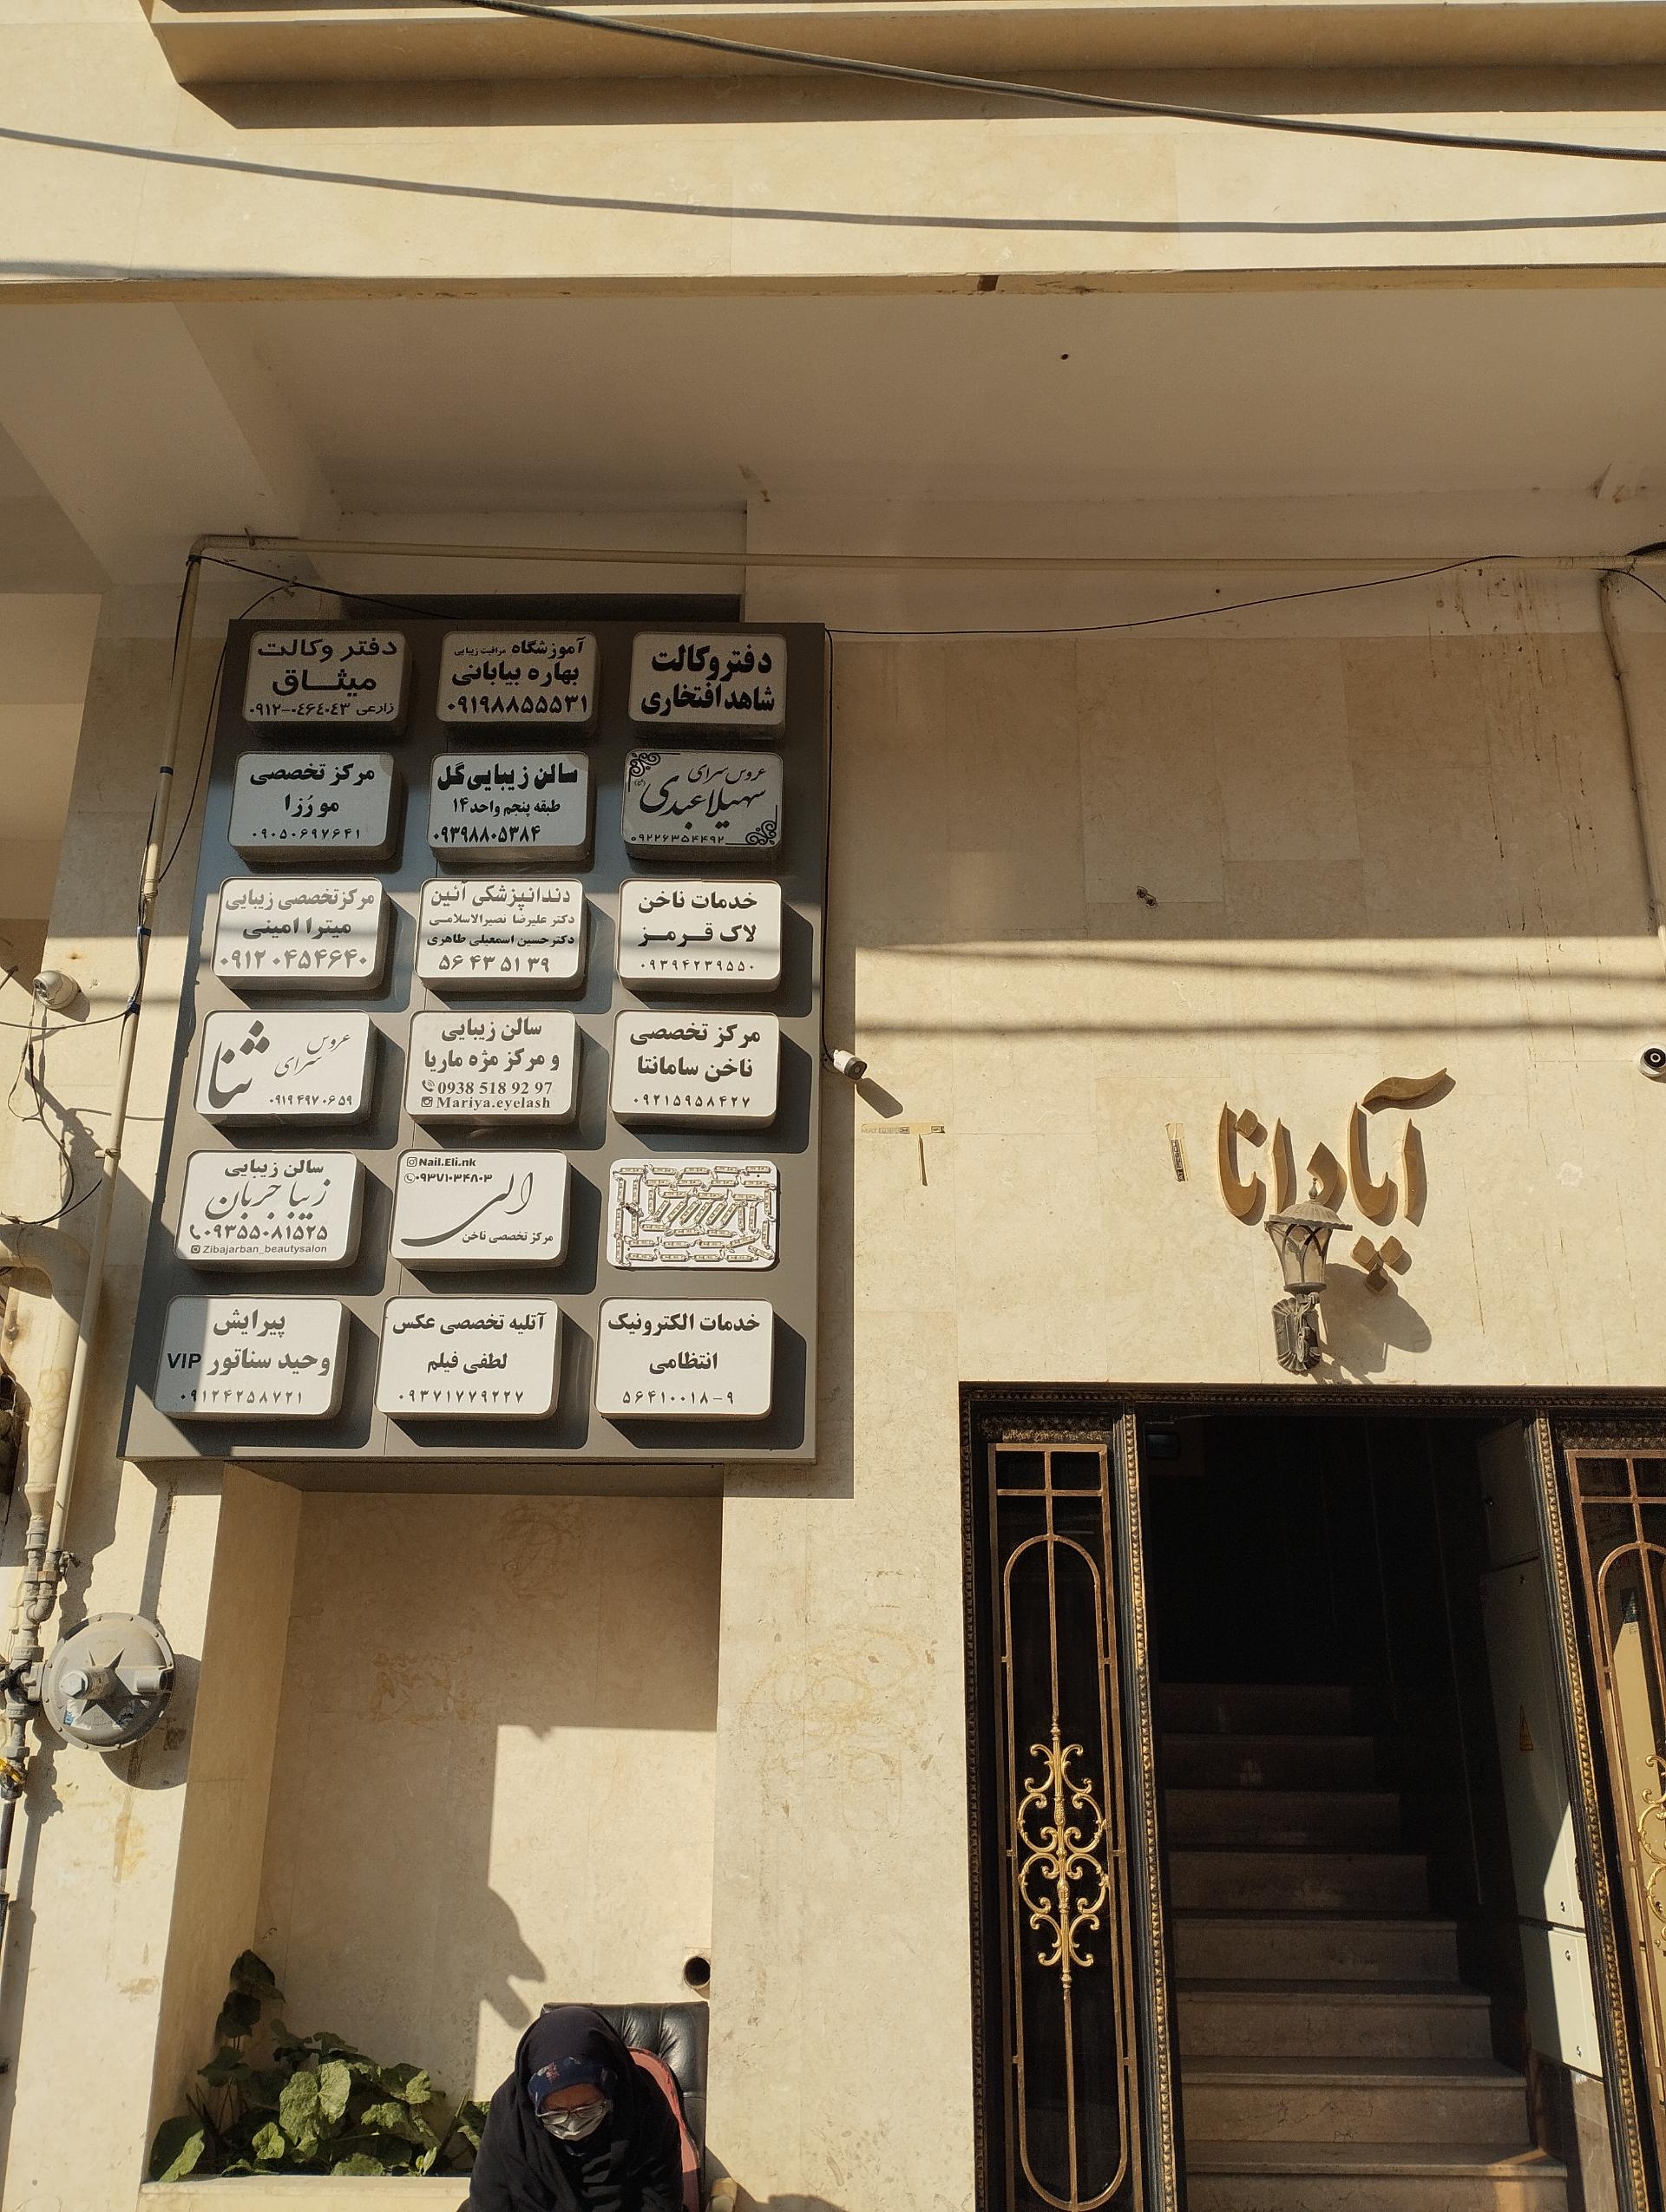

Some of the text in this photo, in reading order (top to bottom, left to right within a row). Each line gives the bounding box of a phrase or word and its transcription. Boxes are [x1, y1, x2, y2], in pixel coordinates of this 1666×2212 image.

[258, 637, 397, 663] دفتر وکالت
[511, 637, 587, 659] آموزشگاه
[451, 660, 579, 687] بهاره بیابانی
[652, 644, 772, 682] دفتر وکالت
[356, 703, 395, 716] زارعی
[447, 694, 587, 714] ۰۹۱۹۸۸۵۵۵۳۱
[641, 682, 775, 717] شاهد افتخاری
[249, 762, 375, 786] مرکز تخصصی
[437, 761, 578, 791] سالن زیبایی گل
[688, 763, 766, 785] عروس سرای
[453, 796, 561, 817] طبقه پنجم واحد ۱۴
[639, 775, 766, 830] سهیلا عبدی
[252, 828, 361, 840] ۰۹۰۵۰۶۹۷۶۴۱
[433, 825, 541, 843] ۰۹۳۹۸۸۰۵۳۸۴
[226, 887, 375, 910] مرکز تخصصی زیبایی
[430, 880, 571, 911] دندانپزشکی آئین
[638, 891, 758, 913] خدمات ناخن
[242, 916, 351, 939] میترا امینی
[512, 913, 548, 927] علیرضا
[549, 913, 575, 927] دکتر
[426, 933, 574, 948] دکتر حسین اسمعیلی طاهری
[719, 924, 757, 943] لاک
[640, 959, 755, 972] ۰۹۳۹۴۲۳۹۵۵۰
[442, 1017, 542, 1042] سالن زیبایی
[630, 1022, 760, 1048] مرکز تخصصی
[306, 1034, 351, 1055] عروس
[208, 1019, 270, 1109] ثنا
[273, 1056, 323, 1077] سرای
[424, 1047, 560, 1073] و مرکز مژه ماریا
[638, 1056, 753, 1083] ناخن سامانتا
[438, 1082, 553, 1095] 0938 518 92 97
[436, 1096, 551, 1110] Mariya.eyelash
[633, 1094, 751, 1108] ۰۹۲۱۵۹۵۸۴۲۷
[225, 1159, 324, 1178] سالن زیبایی
[419, 1158, 476, 1167] Nail.Eli.nk
[416, 1173, 493, 1182] ۰۹۳۷۱۰۳۴۸۰۳
[287, 1179, 331, 1220] زیبا
[204, 1224, 328, 1240] ۰۹۳۵۵۰۸۱۵۲۵
[462, 1231, 554, 1244] مرکز تخصصی ناخن
[202, 1244, 327, 1255] Zibajarban_beautysalon
[213, 1308, 285, 1338] پیرایش
[392, 1312, 548, 1335] آتلیه تخصصی عکس
[607, 1312, 761, 1336] خدمات الکترونیک
[167, 1347, 331, 1377] وحید سناتور VIP
[427, 1351, 508, 1374] لطفی فیلم
[649, 1351, 718, 1374] انتظامی
[180, 1390, 303, 1404] ۰۹۱۲۴۲۵۸۷۲۱
[398, 1390, 524, 1404] ۰۹۳۷۱۷۷۹۲۲۷
